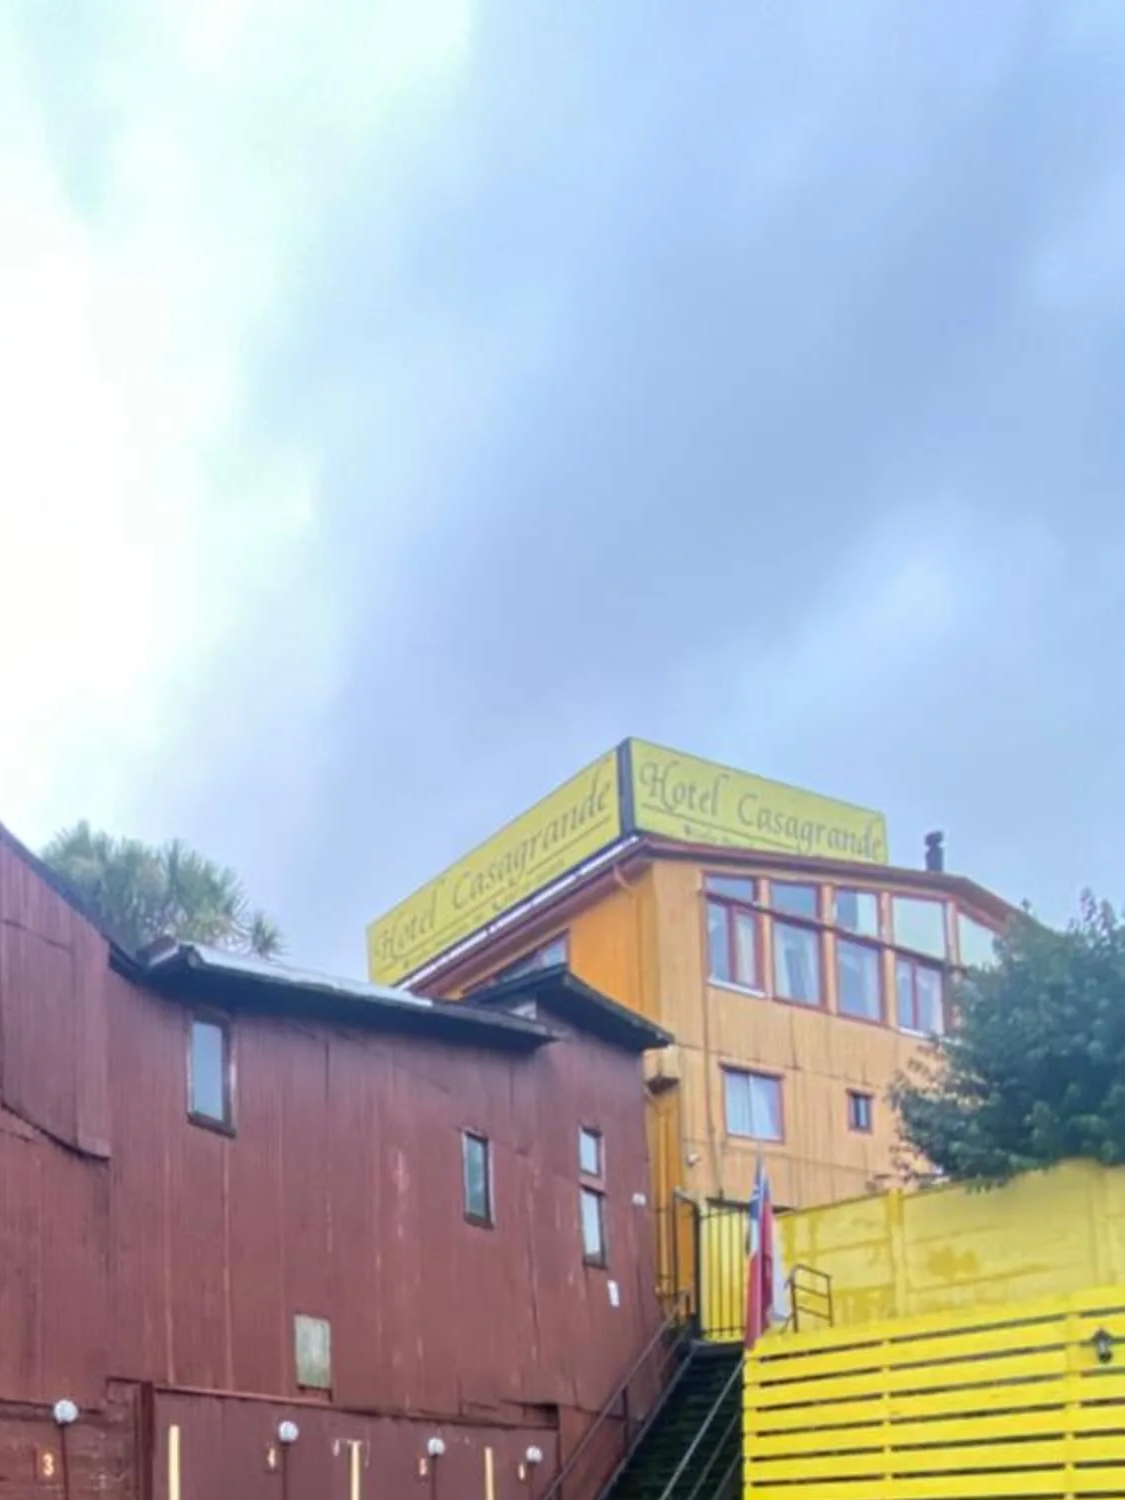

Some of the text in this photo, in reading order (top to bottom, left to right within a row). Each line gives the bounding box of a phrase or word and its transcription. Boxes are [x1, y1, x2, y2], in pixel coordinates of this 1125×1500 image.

[638, 759, 730, 817] Hotel
[736, 793, 883, 860] Casagrande
[42, 1452, 55, 1477] 3
